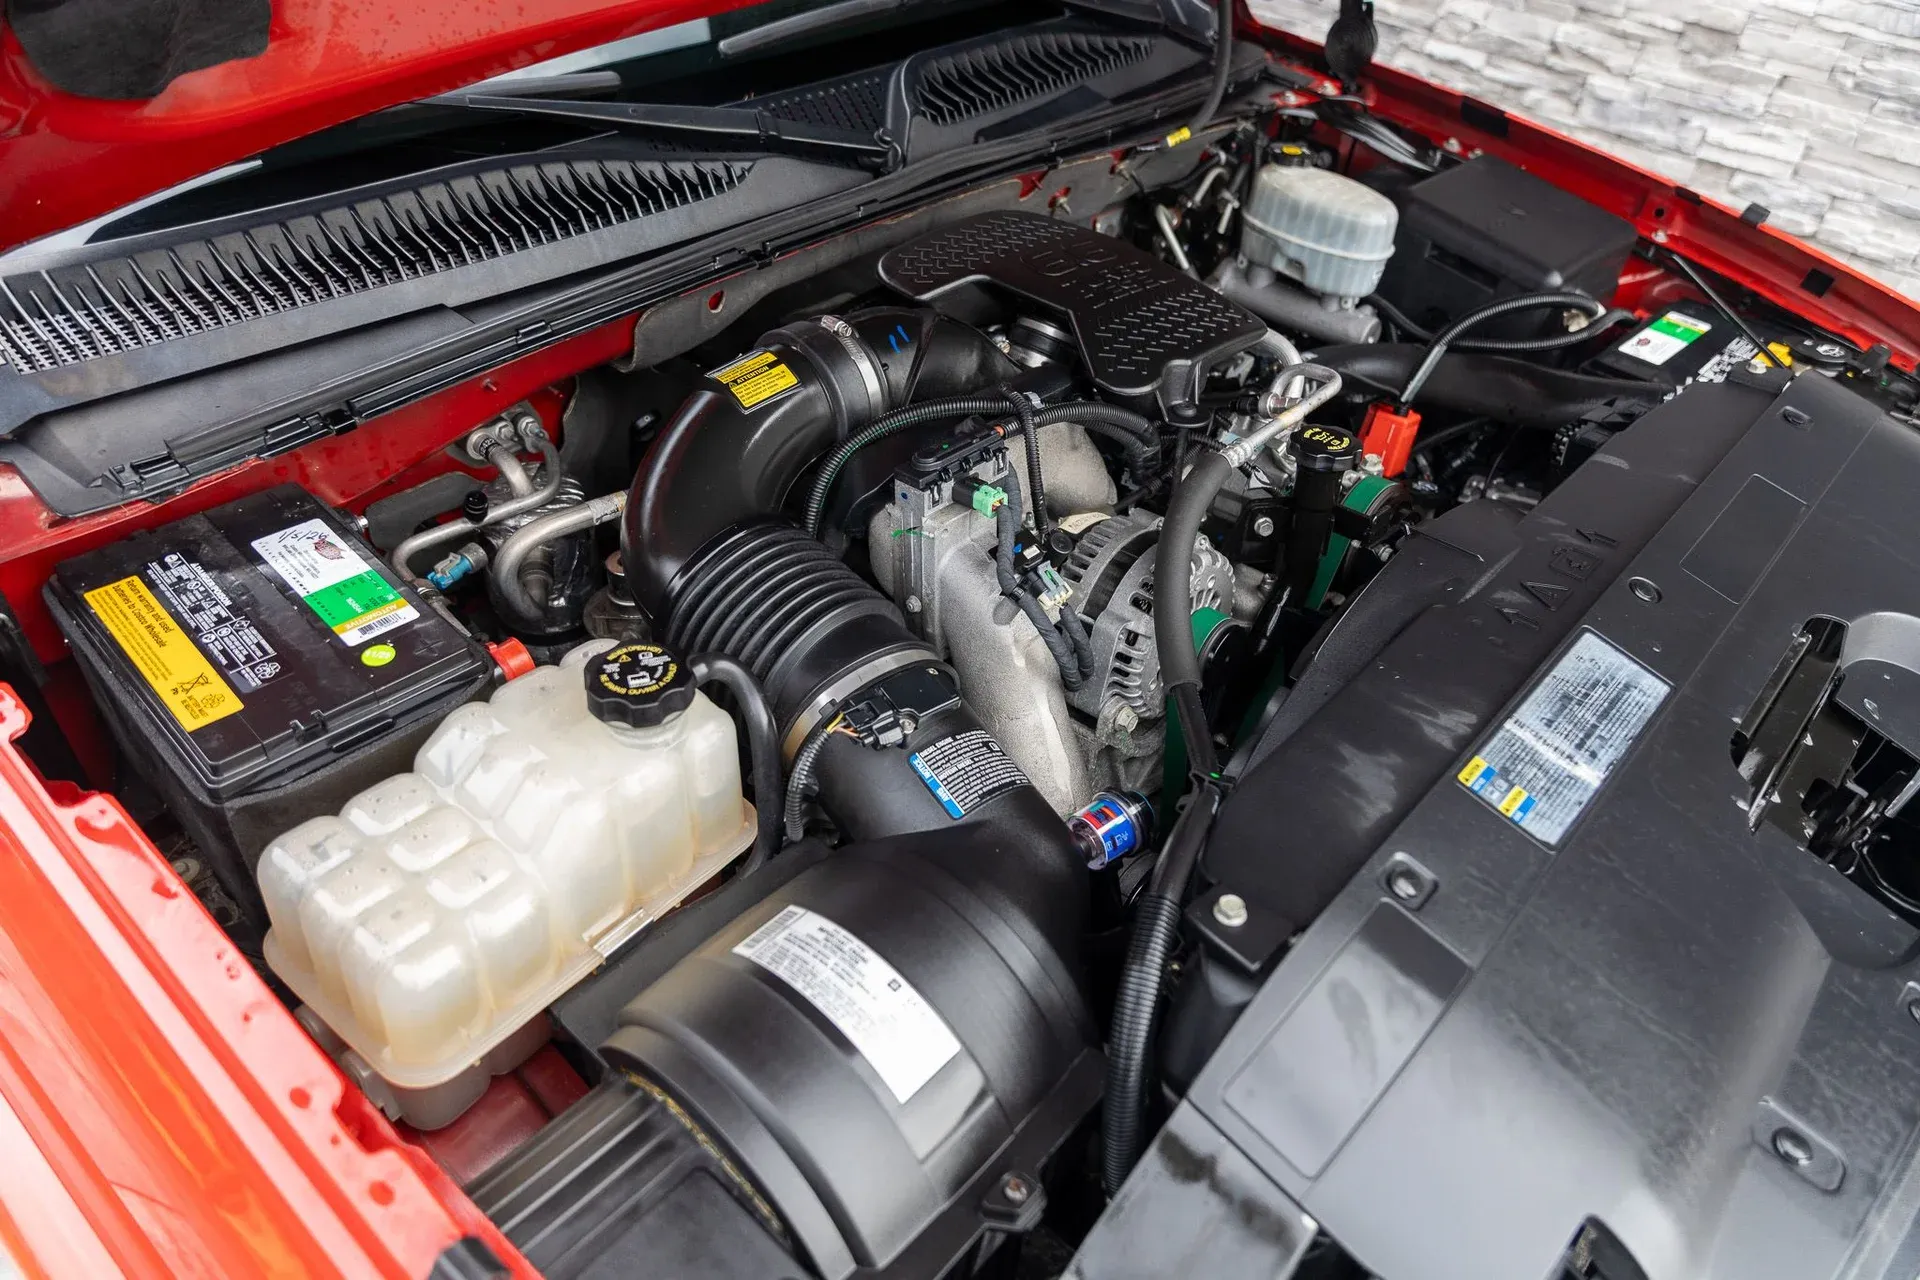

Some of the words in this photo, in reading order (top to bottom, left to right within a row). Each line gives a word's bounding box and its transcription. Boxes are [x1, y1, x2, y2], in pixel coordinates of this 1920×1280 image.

[736, 365, 769, 384] ATTENTION
[111, 584, 134, 604] batteries
[125, 579, 143, 595] Return
[126, 602, 138, 610] to
[134, 593, 156, 614] warranty
[130, 608, 150, 625] Costco
[151, 611, 165, 622] and
[157, 619, 174, 633] used
[345, 604, 397, 630] AUTOMOTIVE
[142, 623, 169, 648] Wholesale
[920, 745, 937, 758] DIESEL
[935, 736, 954, 748] ENGINE
[912, 757, 932, 780] NOTICE
[937, 766, 959, 781] MOTEUR
[957, 758, 975, 770] DIESEL
